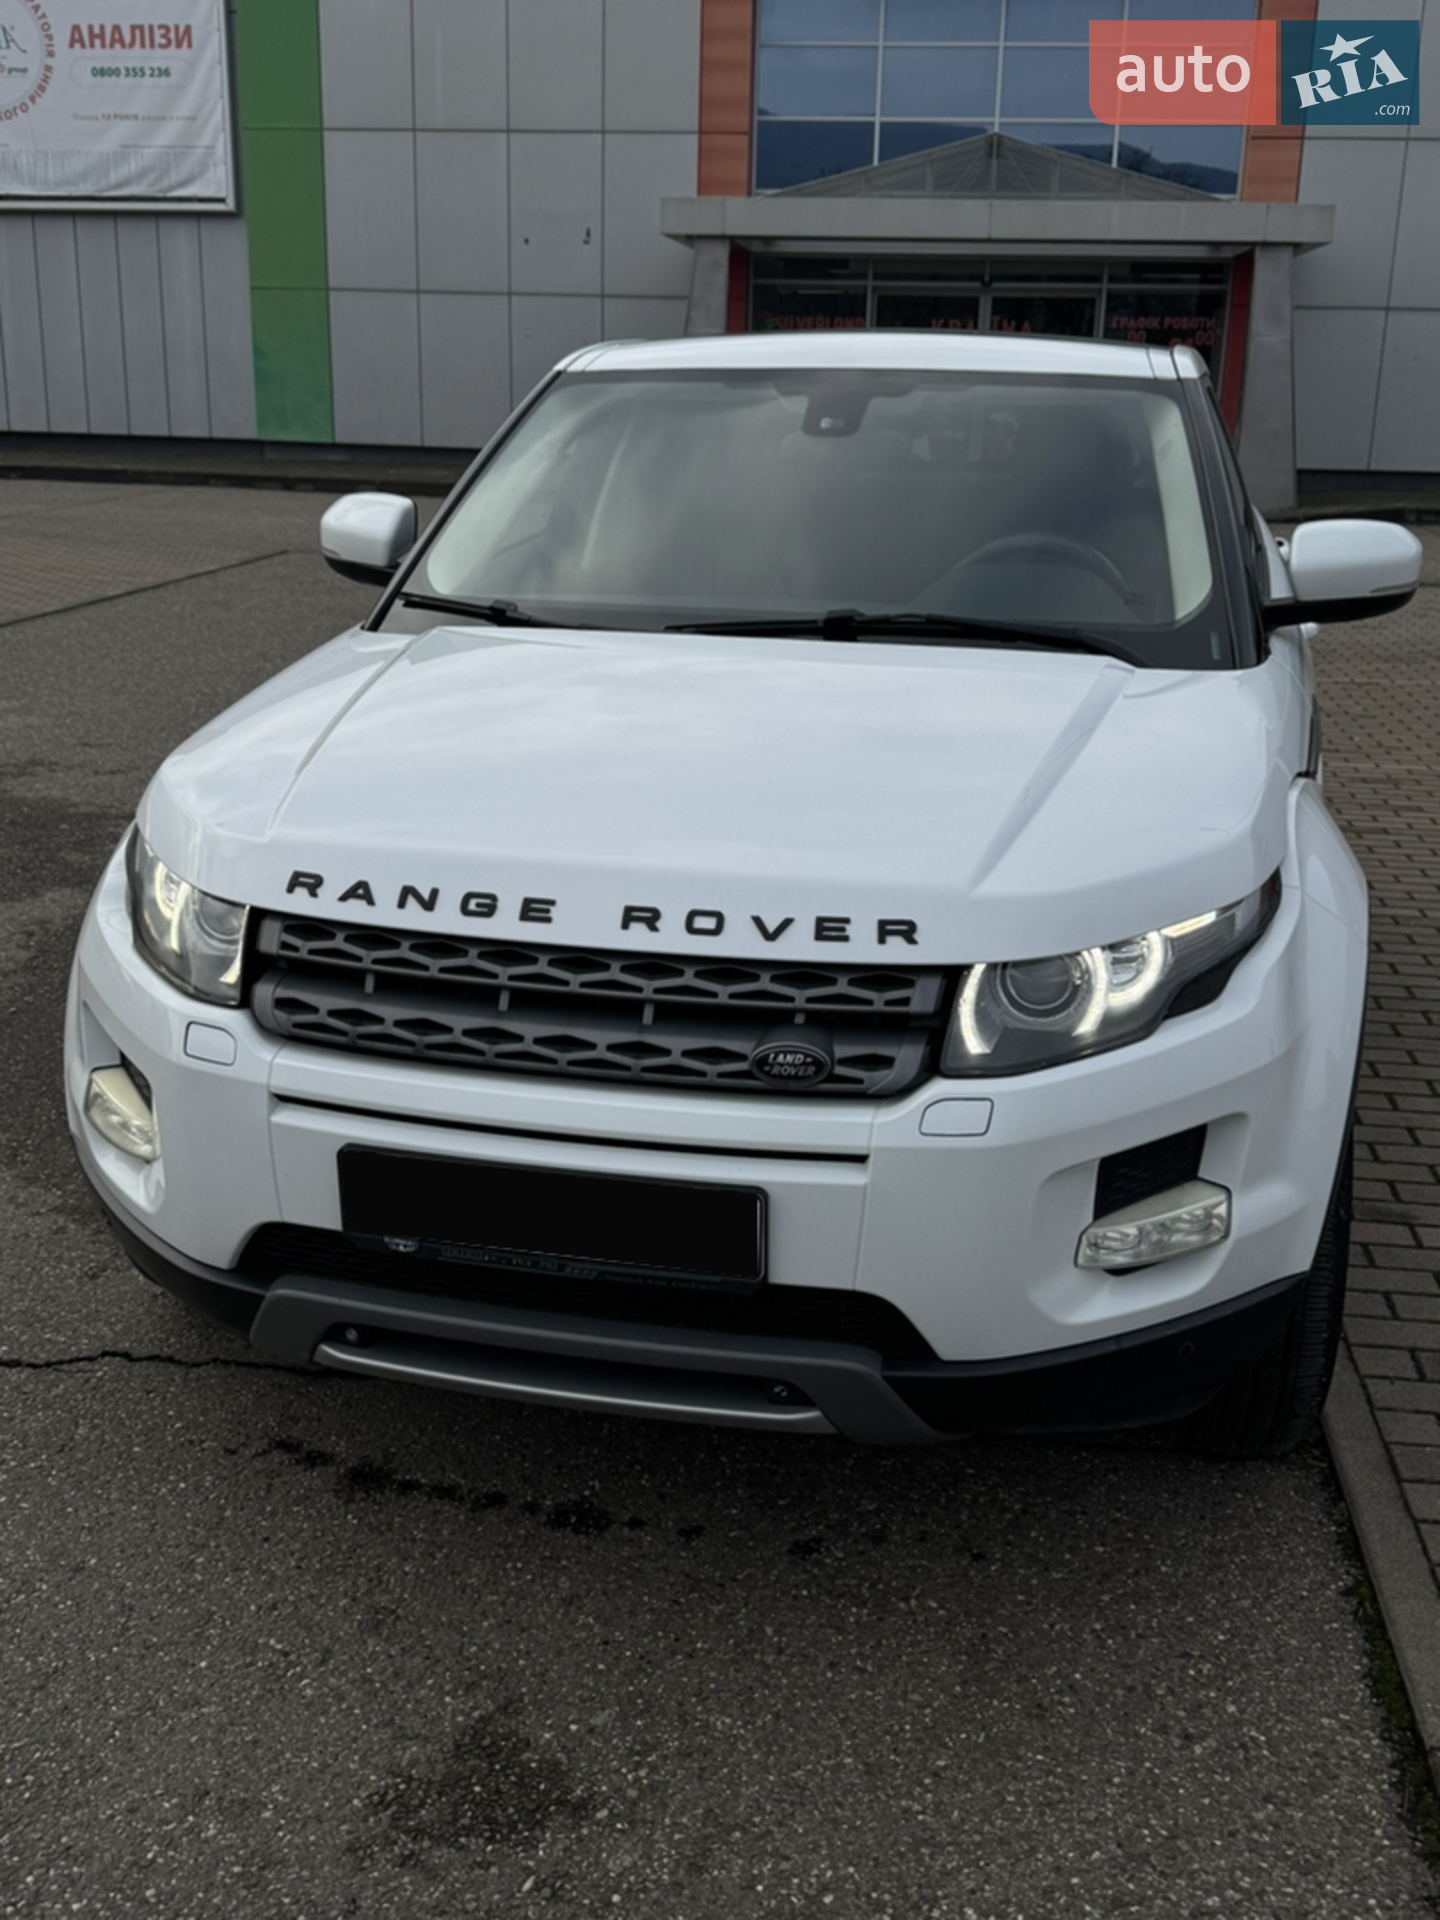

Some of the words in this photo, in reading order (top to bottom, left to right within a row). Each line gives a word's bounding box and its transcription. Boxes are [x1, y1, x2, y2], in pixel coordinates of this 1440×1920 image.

[68, 24, 194, 50] АНАЛІЗИ
[91, 66, 121, 78] 0800
[124, 66, 146, 78] 355
[148, 66, 171, 78] 236
[28, 64, 54, 106] РІВНЯ
[1111, 316, 1160, 329] ГРАФІК
[1163, 316, 1216, 330] РОБОТИ
[286, 870, 557, 924] RANGE
[621, 904, 919, 946] ROVER
[767, 1052, 805, 1064] LAND
[771, 1064, 816, 1077] ROVER
